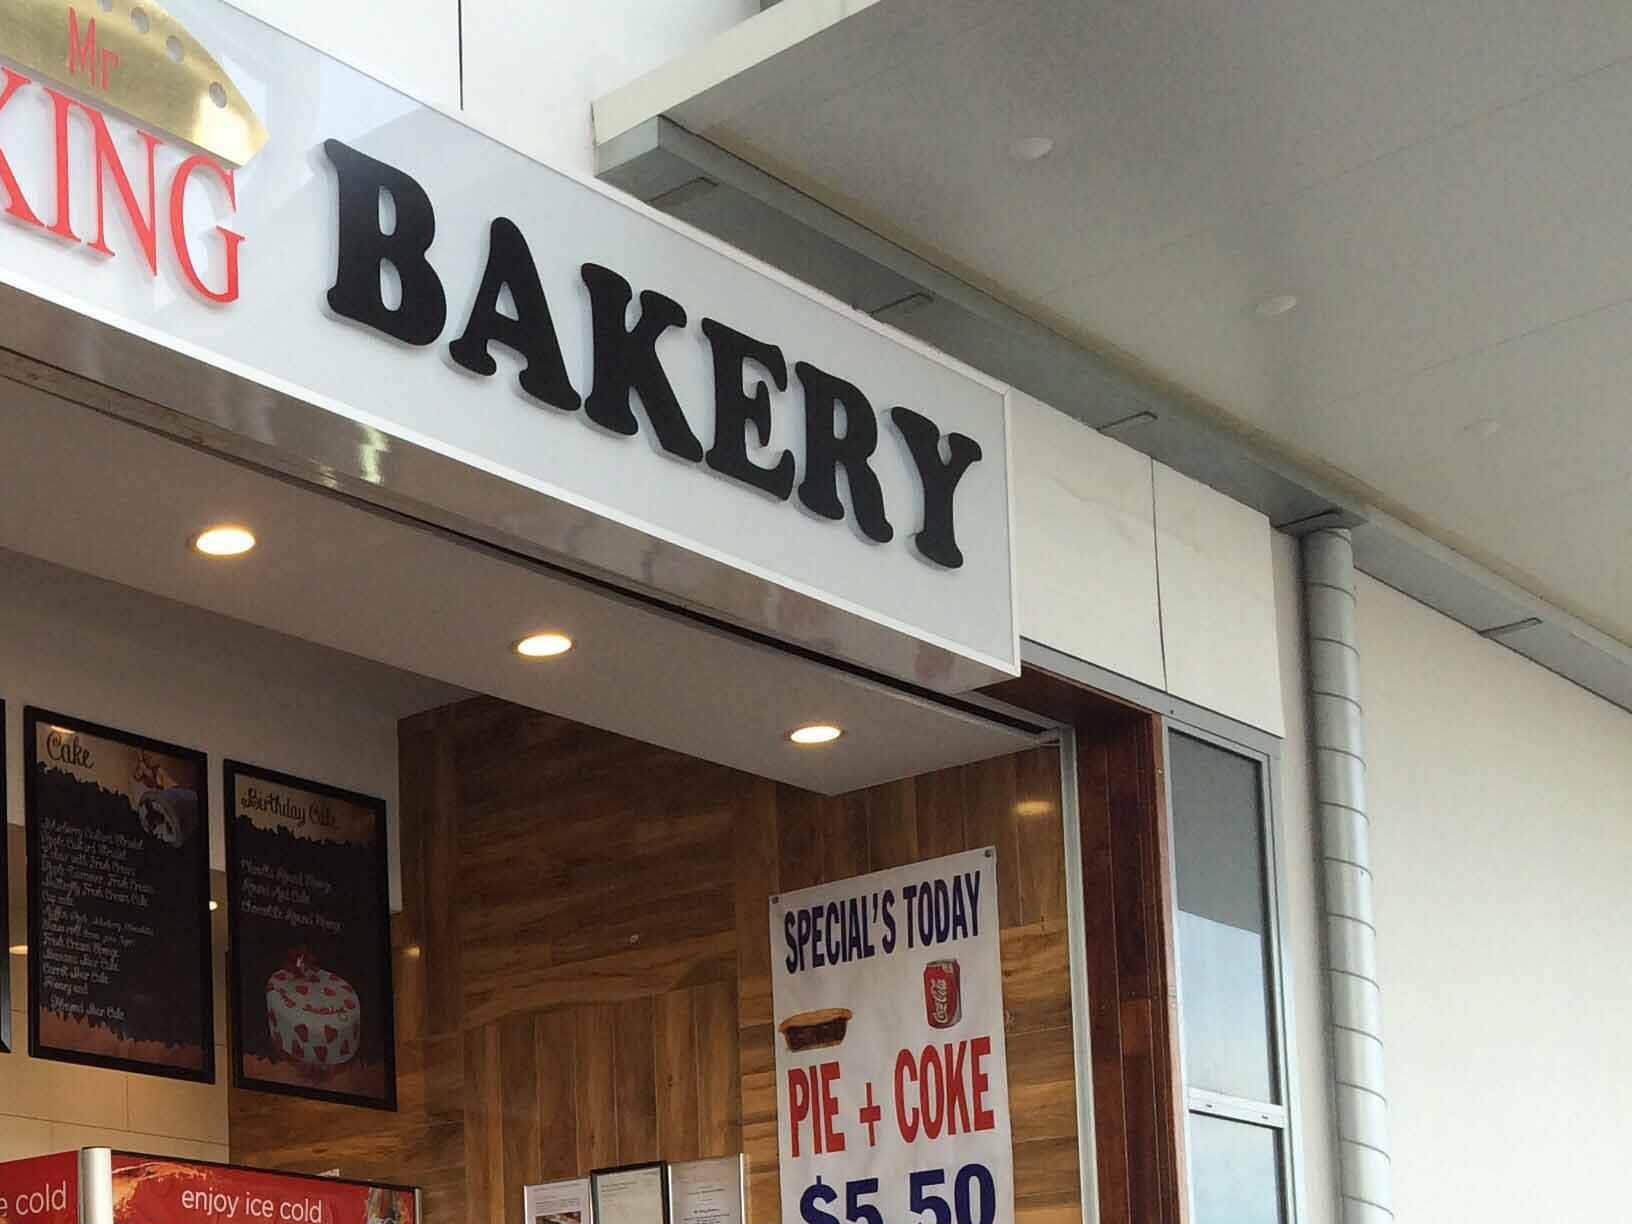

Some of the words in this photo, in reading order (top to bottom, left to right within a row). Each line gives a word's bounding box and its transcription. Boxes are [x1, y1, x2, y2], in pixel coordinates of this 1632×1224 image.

[68, 6, 120, 92] Mr
[323, 138, 983, 570] BAKERY
[46, 731, 96, 769] Cake
[241, 785, 306, 827] Birthday
[783, 891, 898, 975] SPECIAL'S
[902, 870, 981, 950] TODAY
[787, 1061, 846, 1159] PIE
[859, 1081, 882, 1147] +
[894, 1036, 996, 1144] COKE
[15, 1179, 67, 1216] cold
[181, 1188, 239, 1218] enjoy
[244, 1193, 274, 1218] ice
[279, 1197, 323, 1224] cold
